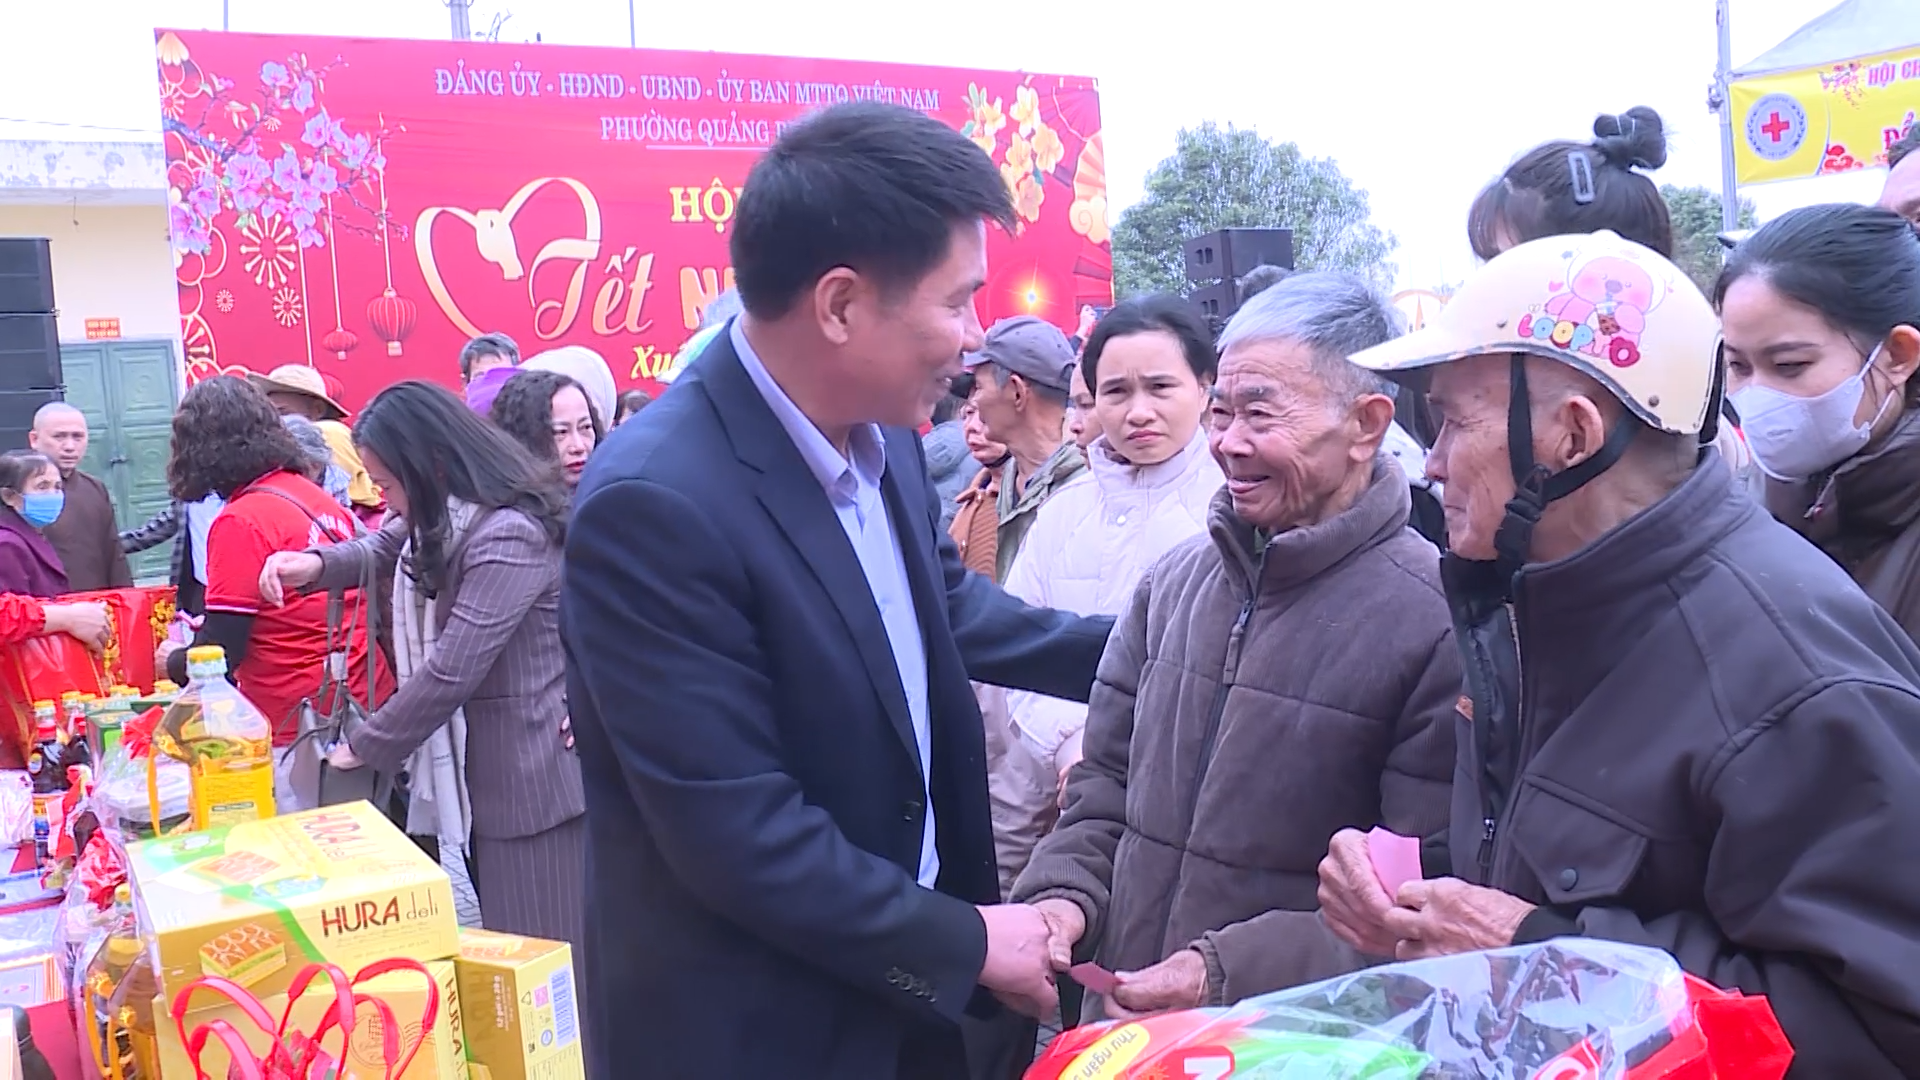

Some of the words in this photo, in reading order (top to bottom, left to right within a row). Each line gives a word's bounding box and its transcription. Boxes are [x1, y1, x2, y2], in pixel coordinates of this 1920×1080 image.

[435, 58, 504, 96] ĐẢNG
[509, 60, 542, 97] ỦY
[558, 72, 625, 98] HĐND
[640, 74, 702, 101] UBND
[716, 68, 745, 103] ỦY
[749, 79, 790, 104] BAN
[899, 87, 940, 111] NAM
[1867, 61, 1896, 87] HỘI
[1900, 58, 1920, 79] CH
[600, 107, 692, 142] PHƯỜNG
[697, 110, 770, 147] QUẢNG
[669, 176, 744, 234] HỘ
[528, 238, 654, 341] Tết
[630, 344, 675, 380] Xu
[321, 895, 400, 938] HURA
[406, 887, 438, 920] deli
[445, 977, 462, 1056] HURA
